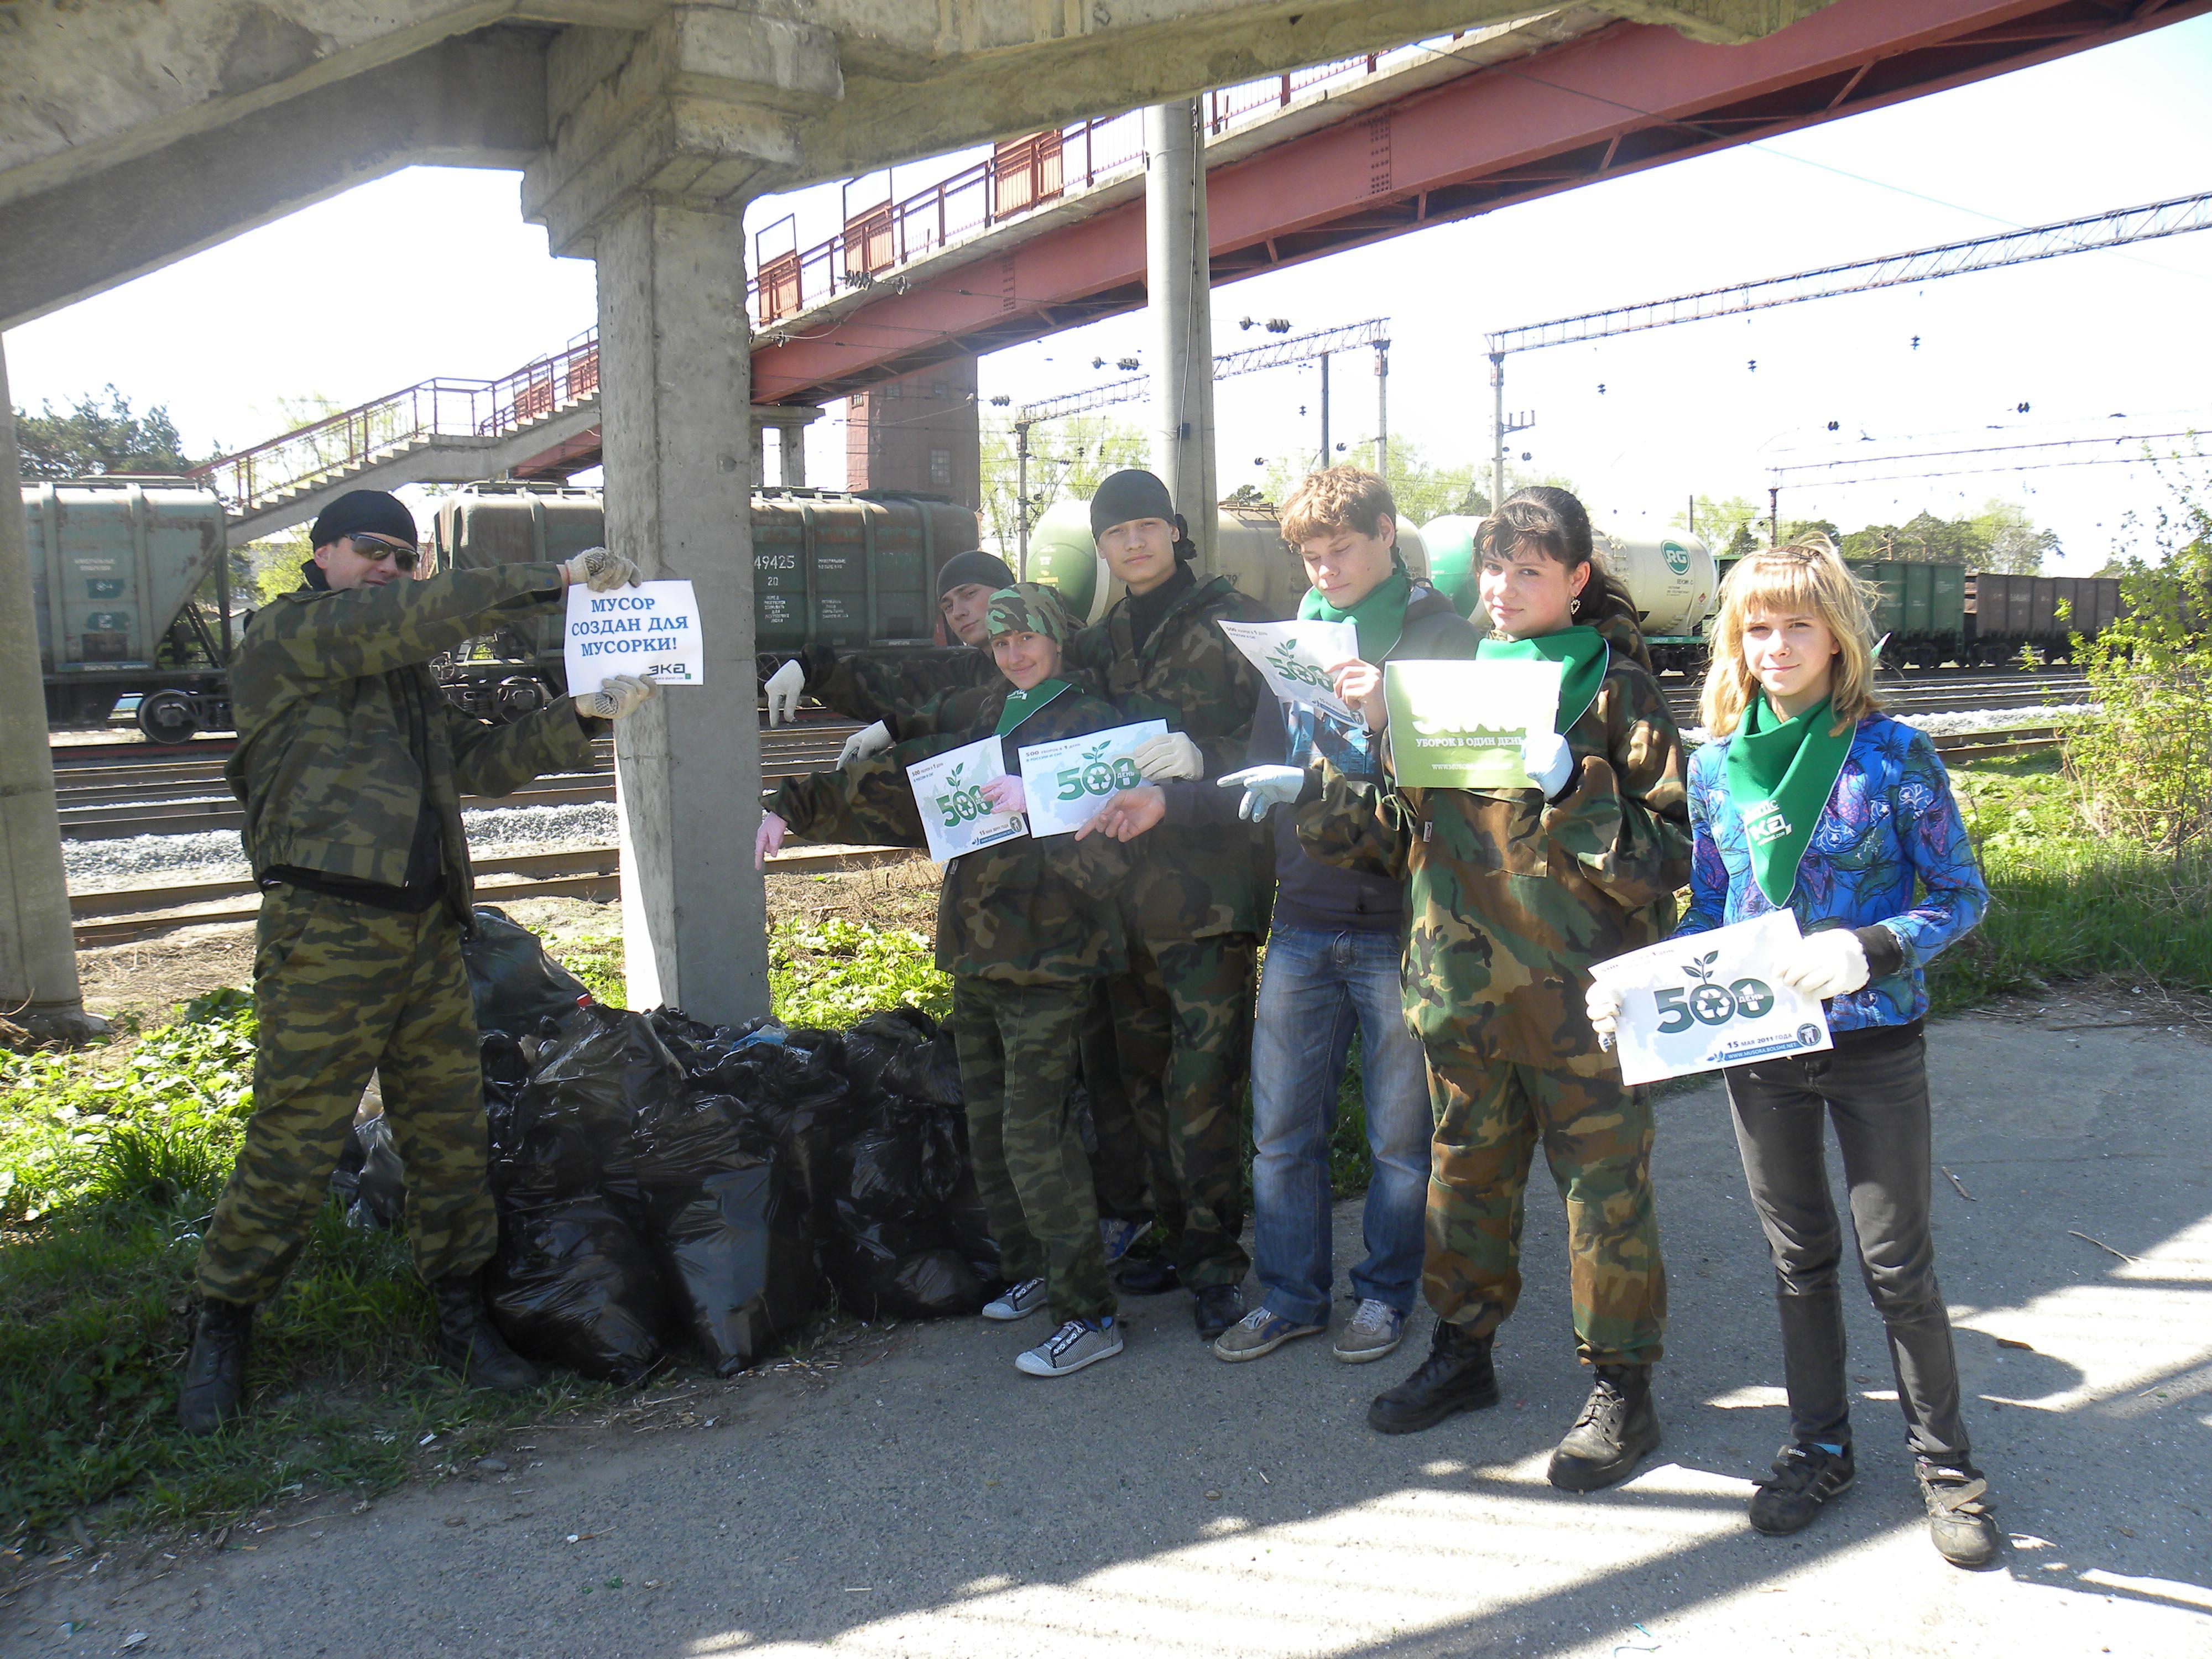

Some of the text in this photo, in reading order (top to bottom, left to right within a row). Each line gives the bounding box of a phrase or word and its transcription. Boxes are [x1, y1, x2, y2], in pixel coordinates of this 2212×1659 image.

[754, 555, 795, 570] 49425
[1665, 550, 1687, 564] RG
[768, 576, 779, 586] 20
[591, 597, 655, 613] МУСОР
[572, 616, 688, 636] СОЗДАН ДЛЯ
[581, 637, 677, 656] МУСОРКИ!
[1416, 737, 1457, 748] УБОРОК
[1457, 737, 1464, 747] В
[1466, 737, 1495, 748] ОДИН
[1057, 758, 1141, 800] 500
[1117, 771, 1134, 779] ДЕНЬ
[1653, 978, 1774, 1034] 500
[1738, 994, 1764, 1004] ДЕНЬ
[1728, 1042, 1797, 1059] WWW.MUSORA.BOLSHE.NET
